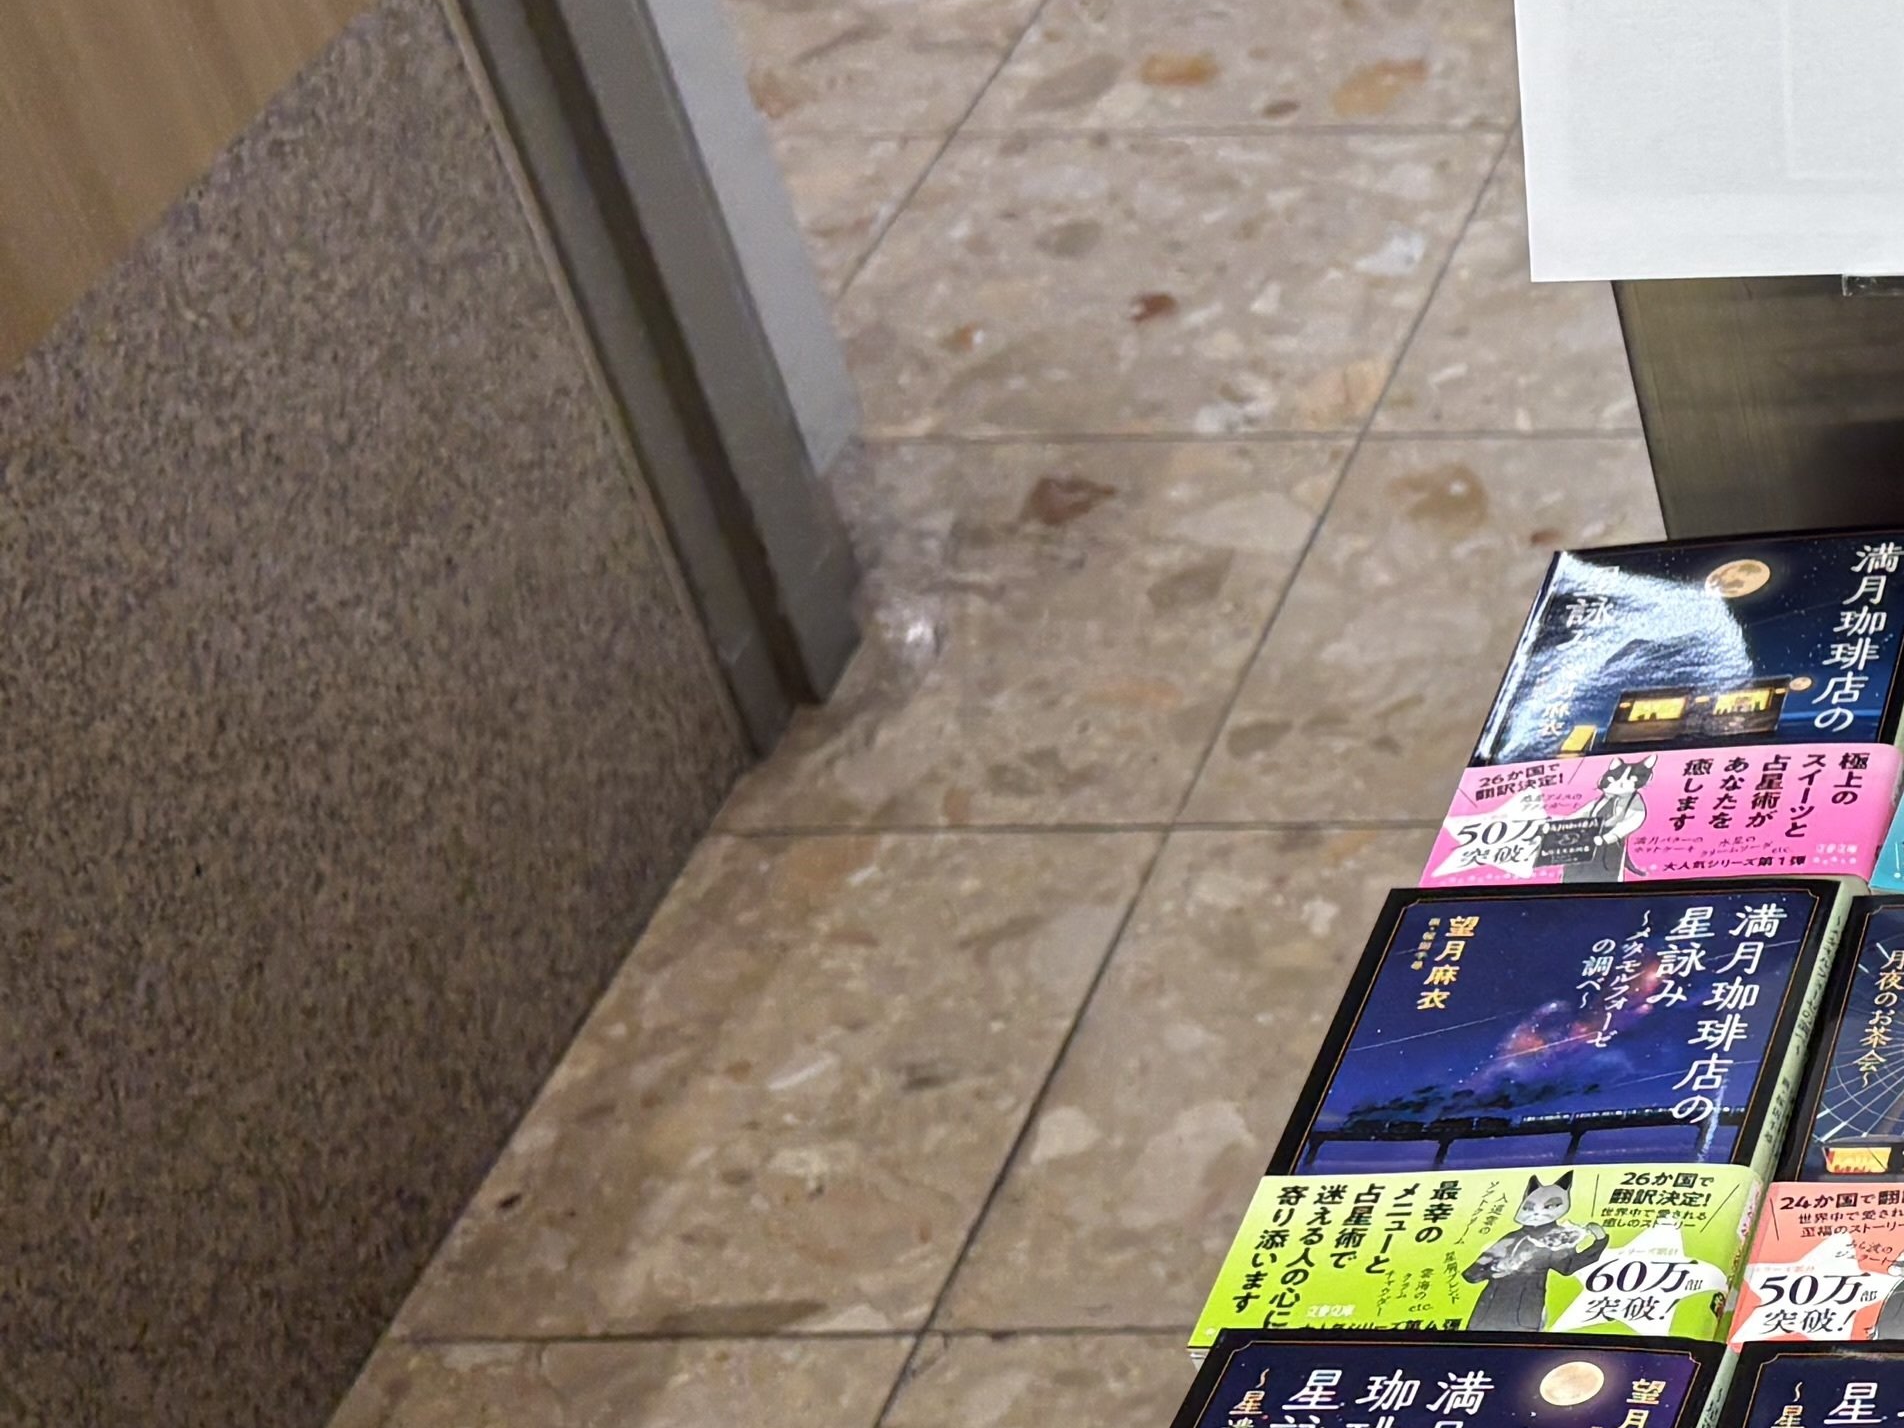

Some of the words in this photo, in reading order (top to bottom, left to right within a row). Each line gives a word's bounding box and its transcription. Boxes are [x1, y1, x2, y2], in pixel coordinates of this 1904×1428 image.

[1707, 758, 1750, 829] あなたを
[1745, 756, 1790, 829] 占星術が
[1415, 915, 1481, 1011] 望月麻衣
[1647, 906, 1716, 1008] 星詠み
[1669, 903, 1788, 1125] 満月珈琲店の
[1328, 1184, 1386, 1270] 占星術で
[1363, 1182, 1422, 1275] メニューと
[1422, 1180, 1463, 1245] 最幸の
